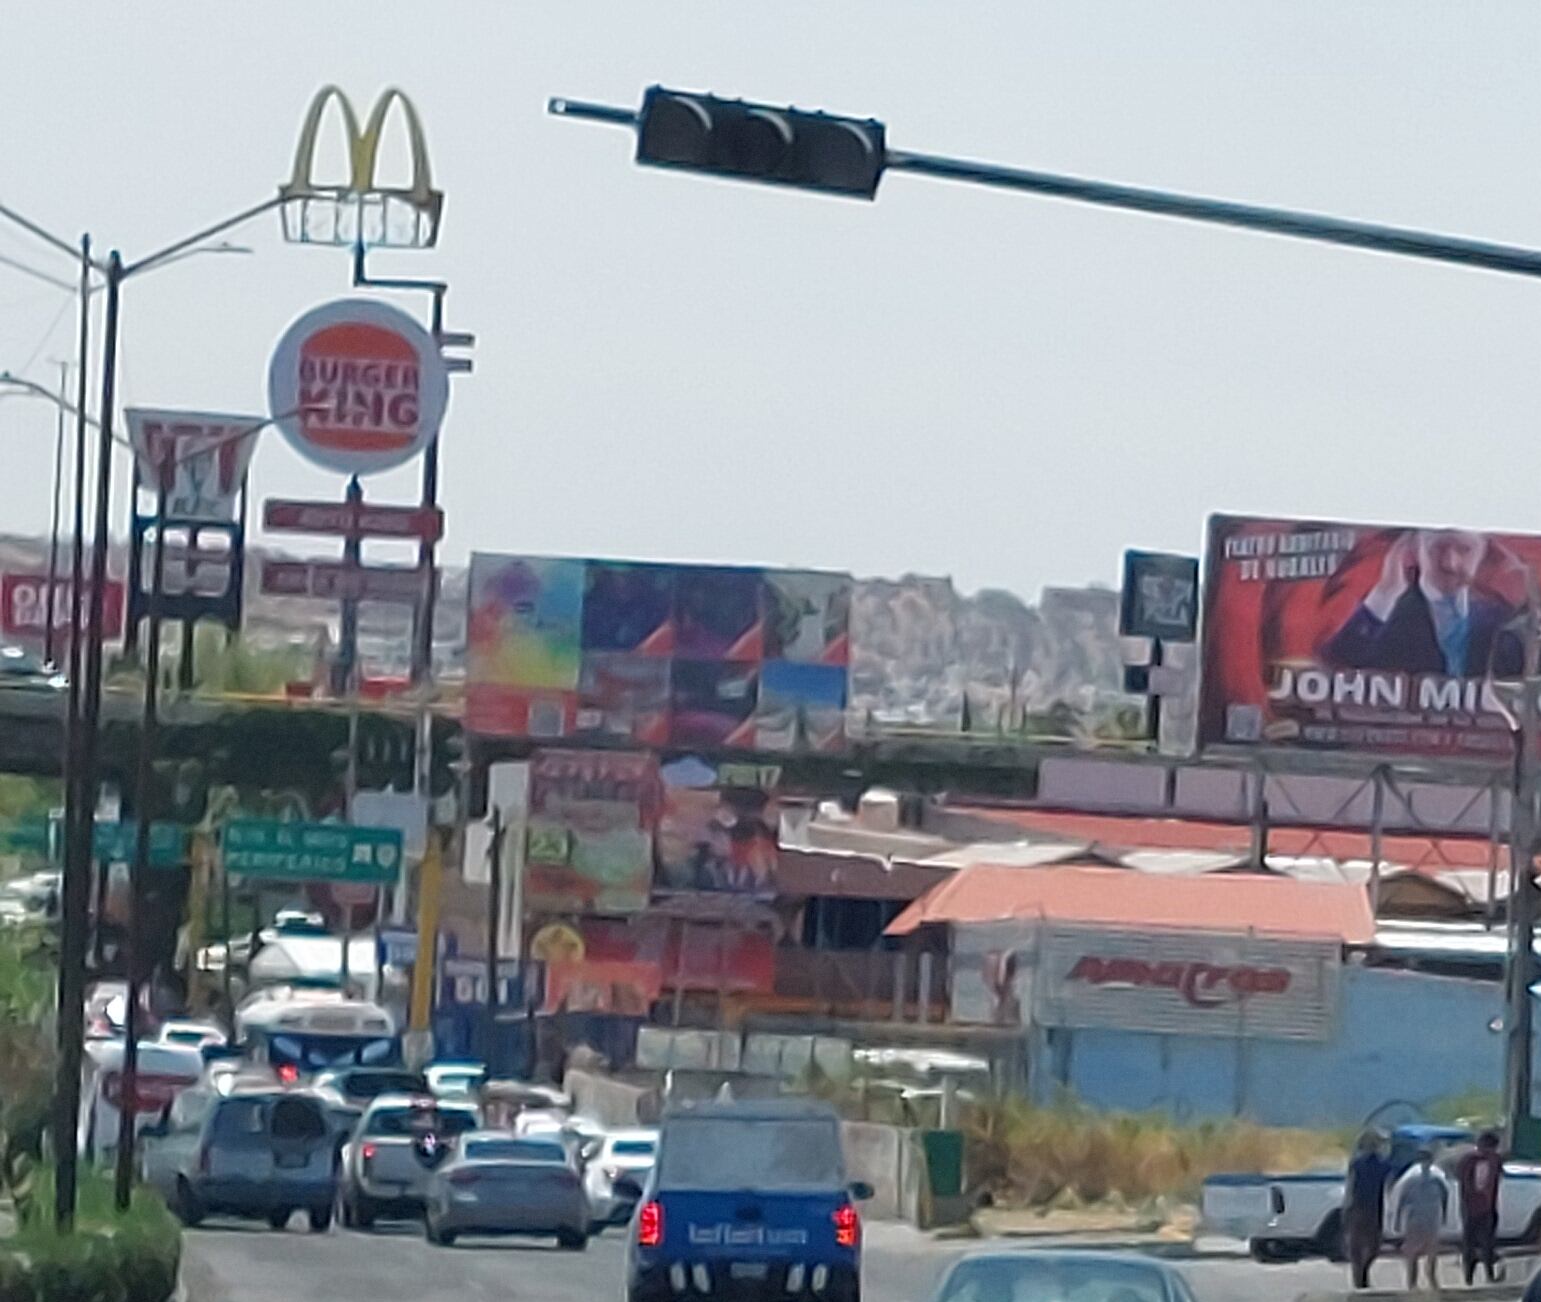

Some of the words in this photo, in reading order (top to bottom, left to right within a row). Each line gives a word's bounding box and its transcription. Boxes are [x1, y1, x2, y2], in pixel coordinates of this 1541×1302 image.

[300, 355, 419, 391] BURGER
[299, 387, 419, 428] KING
[1269, 668, 1402, 707] JOHN
